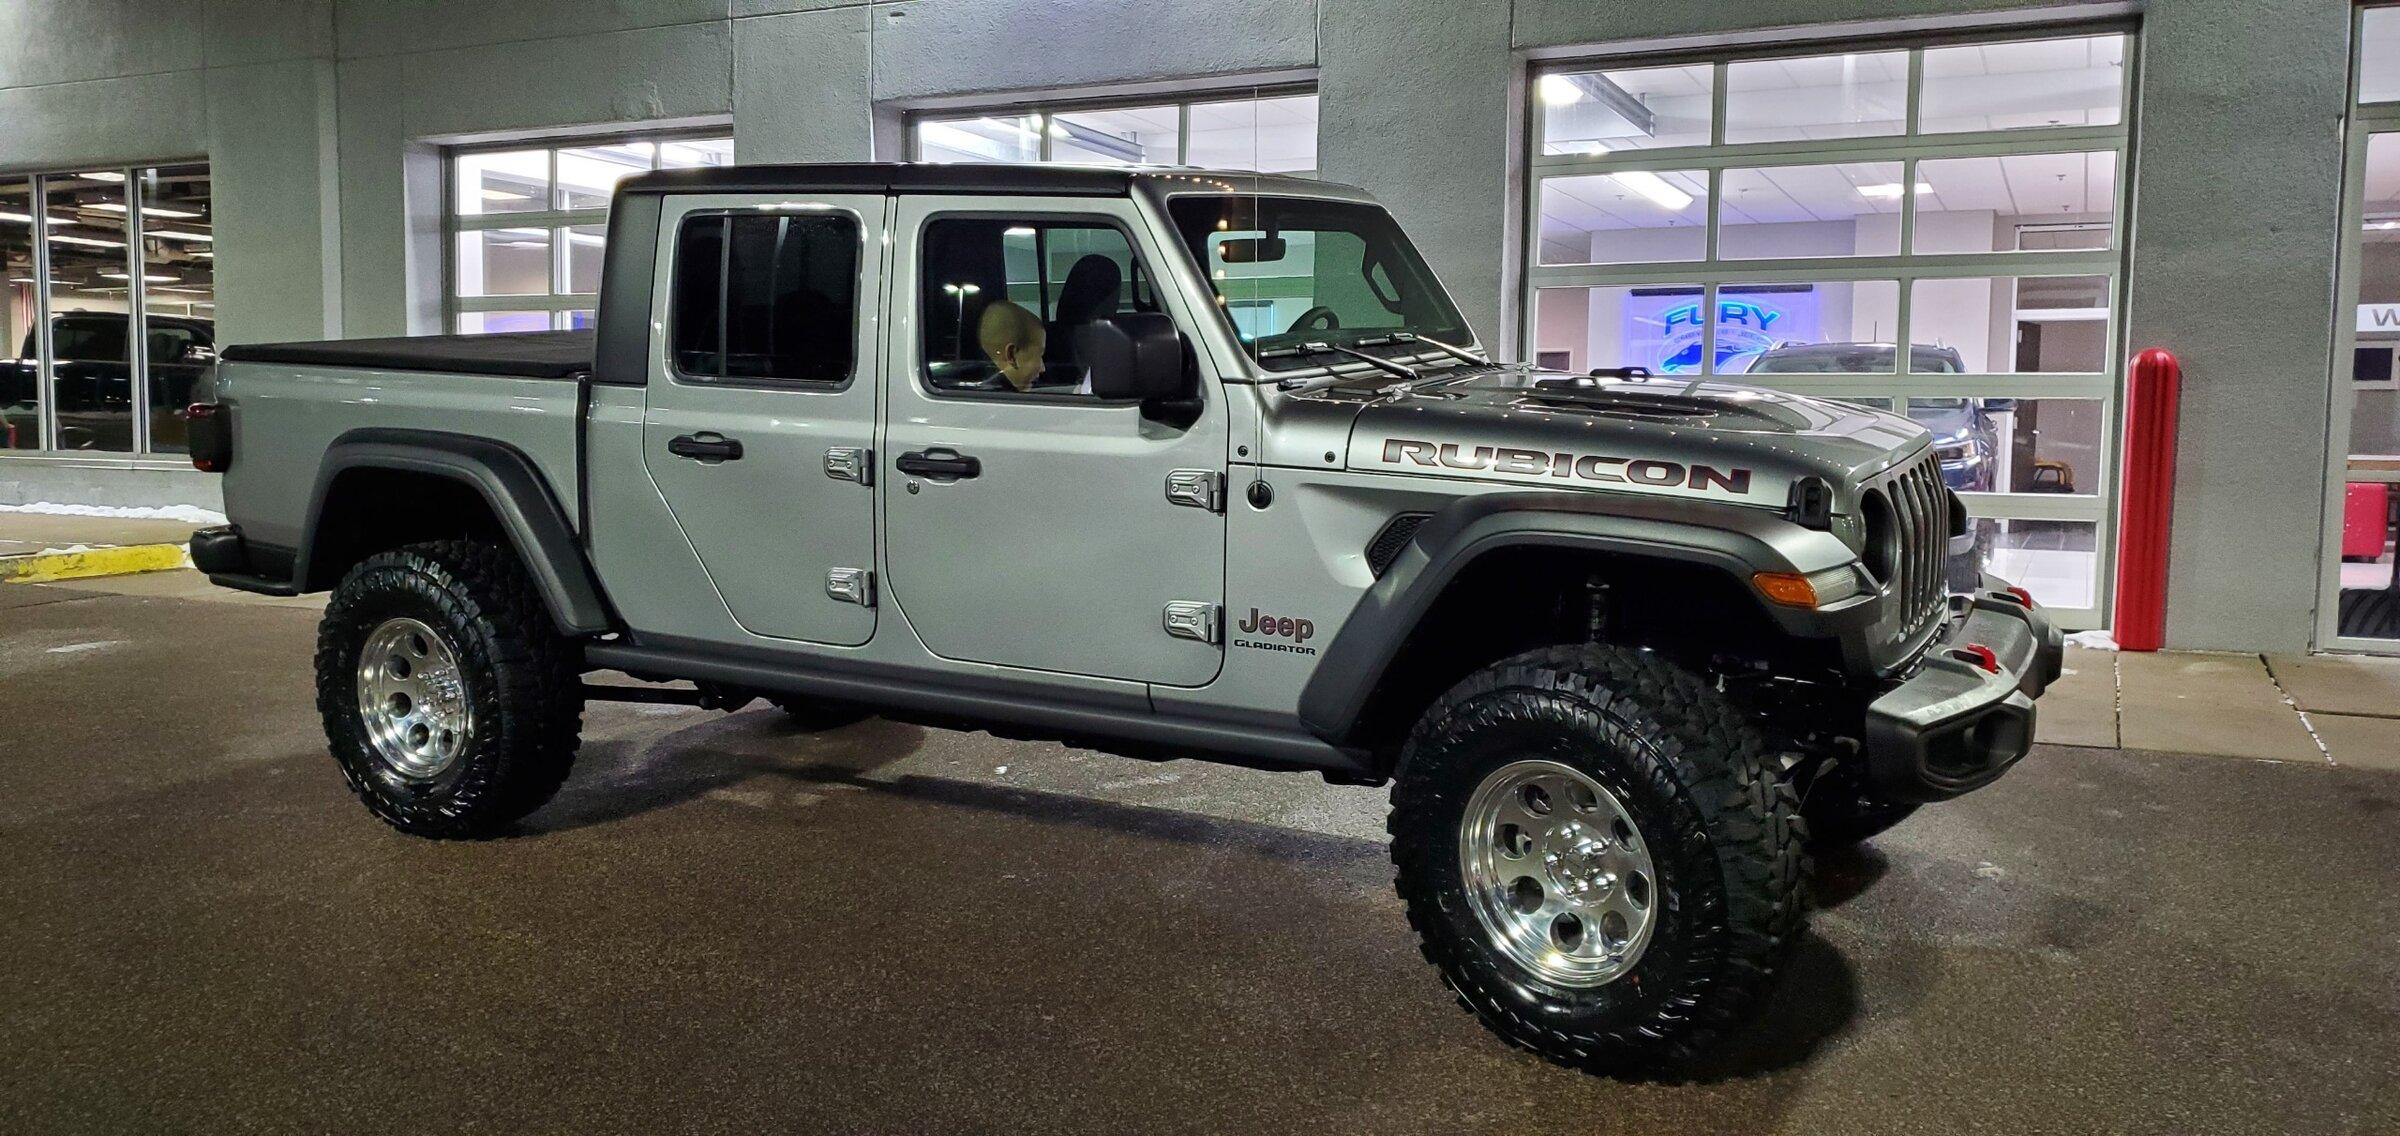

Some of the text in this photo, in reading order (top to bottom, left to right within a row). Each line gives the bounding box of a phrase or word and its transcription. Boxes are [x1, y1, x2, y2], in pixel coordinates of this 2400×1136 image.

[1382, 438, 1751, 494] RUBICON
[1239, 607, 1314, 643] Jeep
[1234, 639, 1316, 656] GLADIATOR
